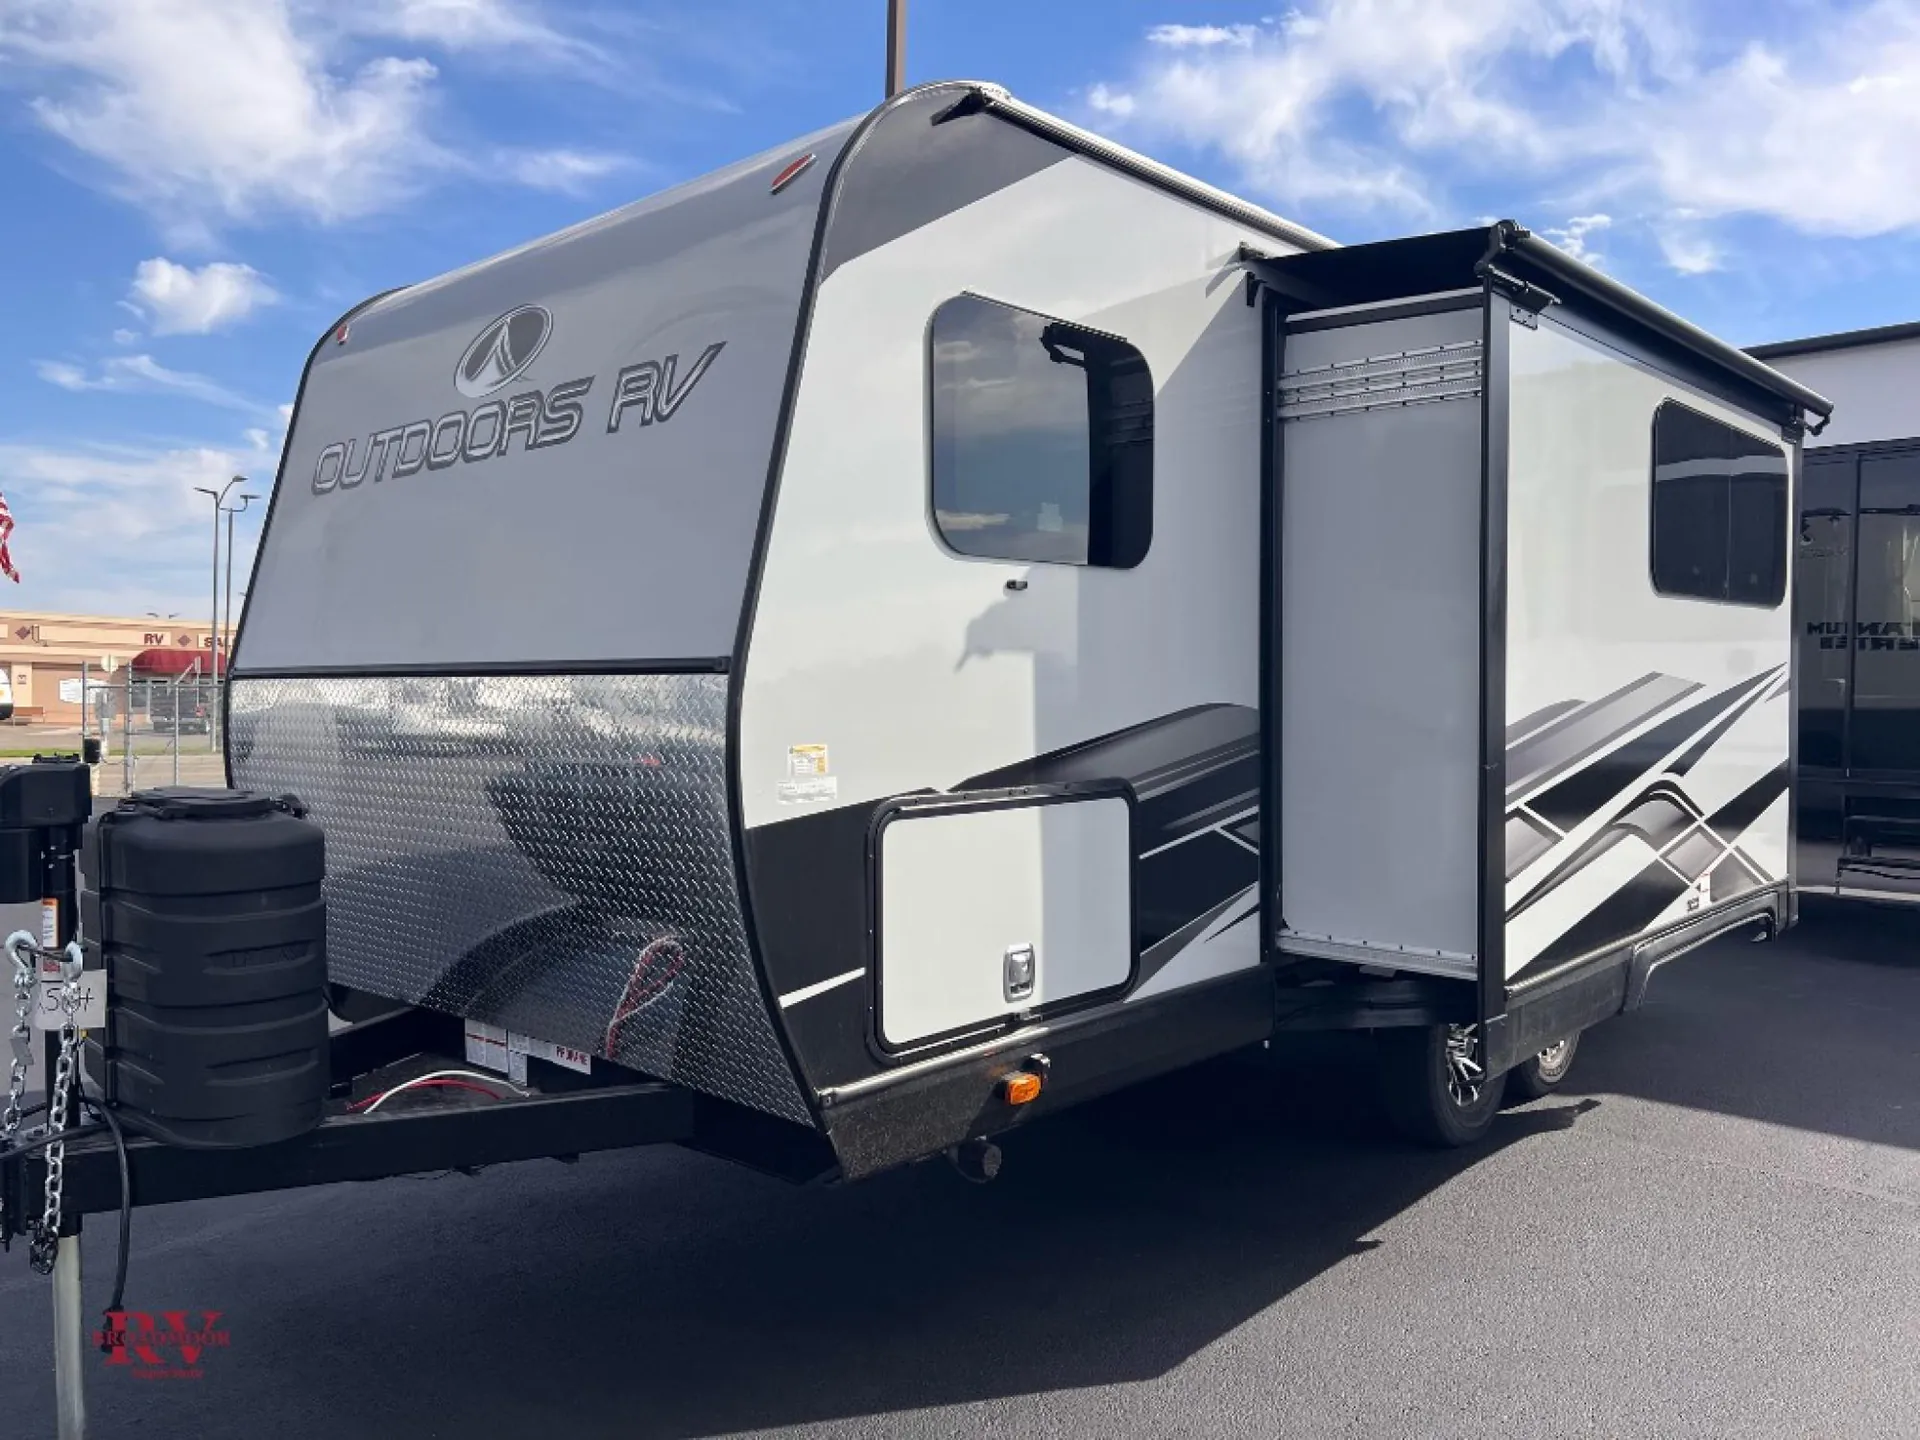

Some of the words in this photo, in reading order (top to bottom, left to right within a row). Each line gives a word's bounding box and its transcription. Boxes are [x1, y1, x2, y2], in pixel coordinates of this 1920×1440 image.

[311, 375, 595, 495] OUTDOORS
[606, 341, 728, 434] RV
[144, 633, 164, 645] RV
